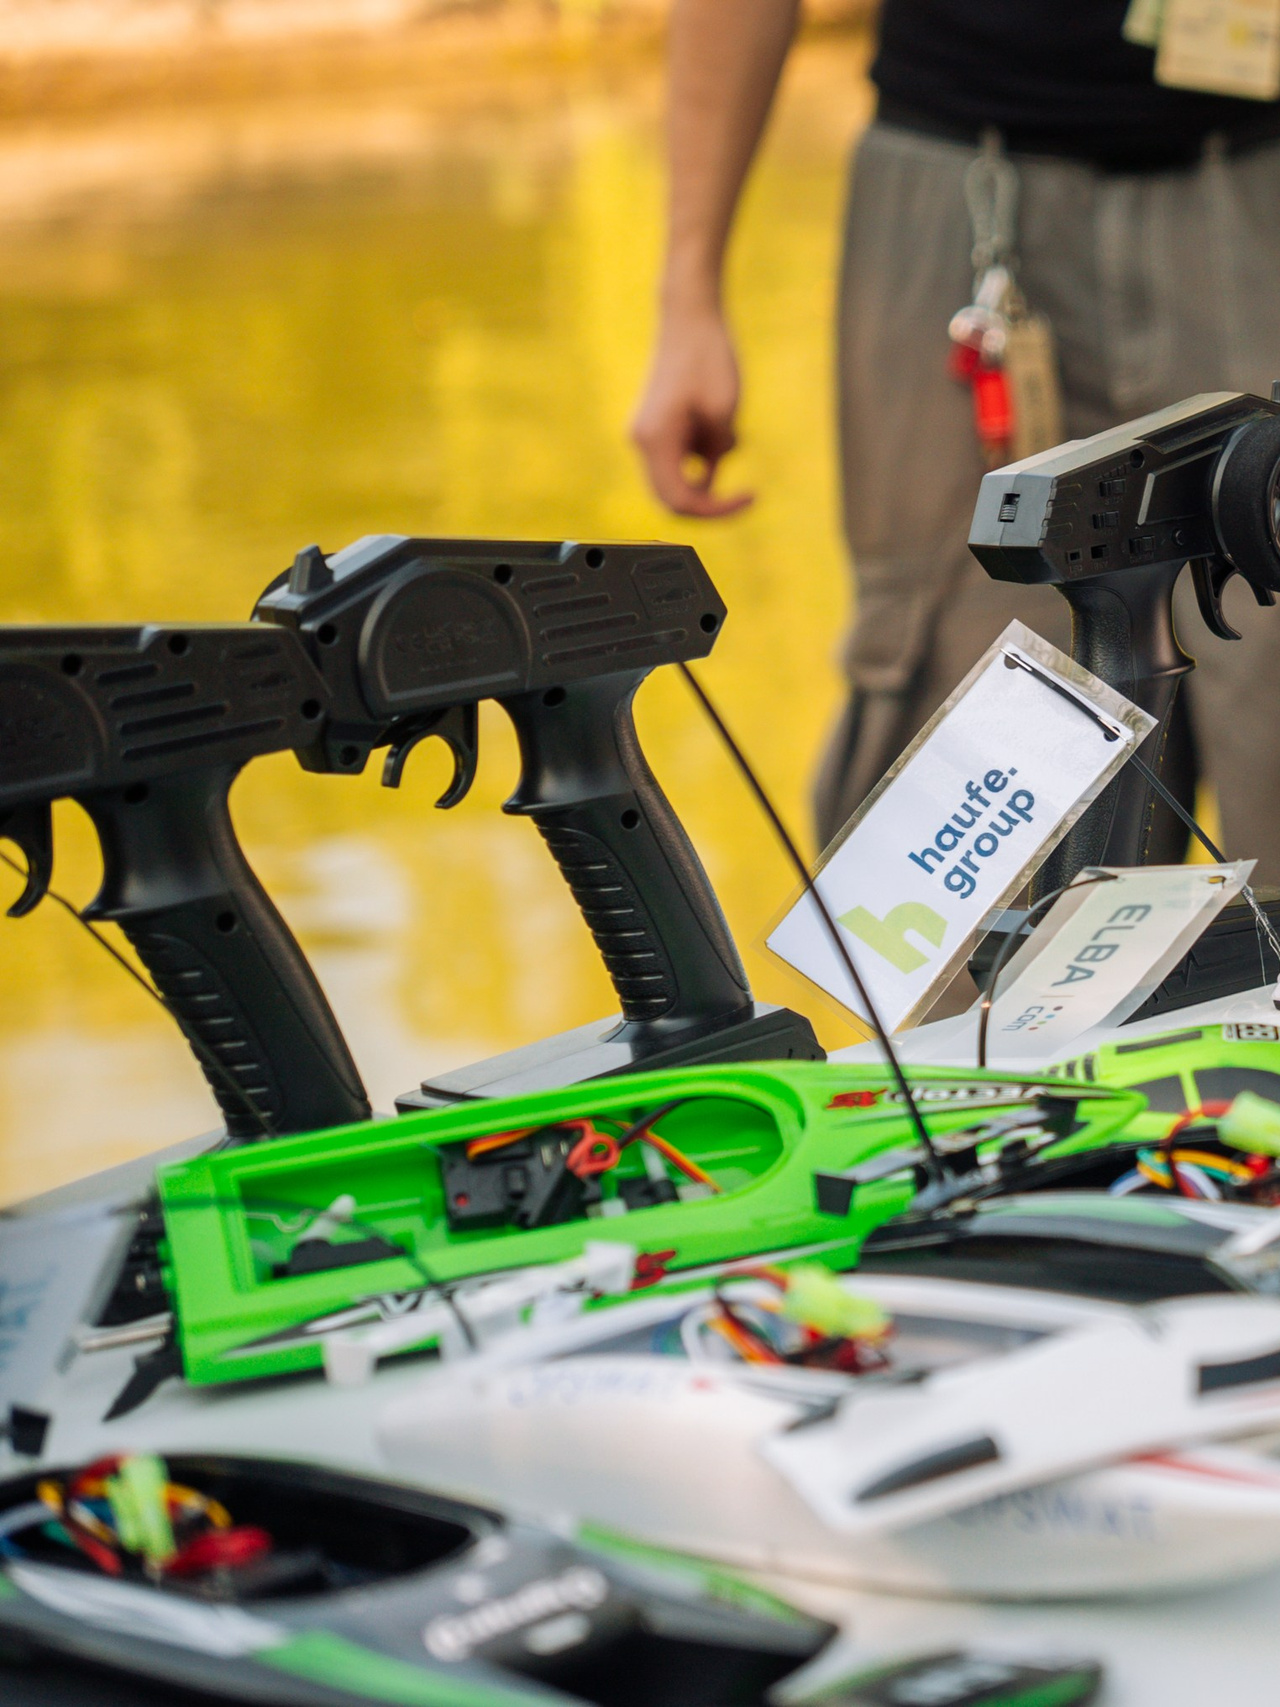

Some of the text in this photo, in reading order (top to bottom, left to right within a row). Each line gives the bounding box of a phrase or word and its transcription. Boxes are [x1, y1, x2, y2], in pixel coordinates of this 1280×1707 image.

[907, 766, 1018, 875] haufe.
[943, 789, 1035, 900] group
[1001, 903, 1152, 1032] ELBA com
